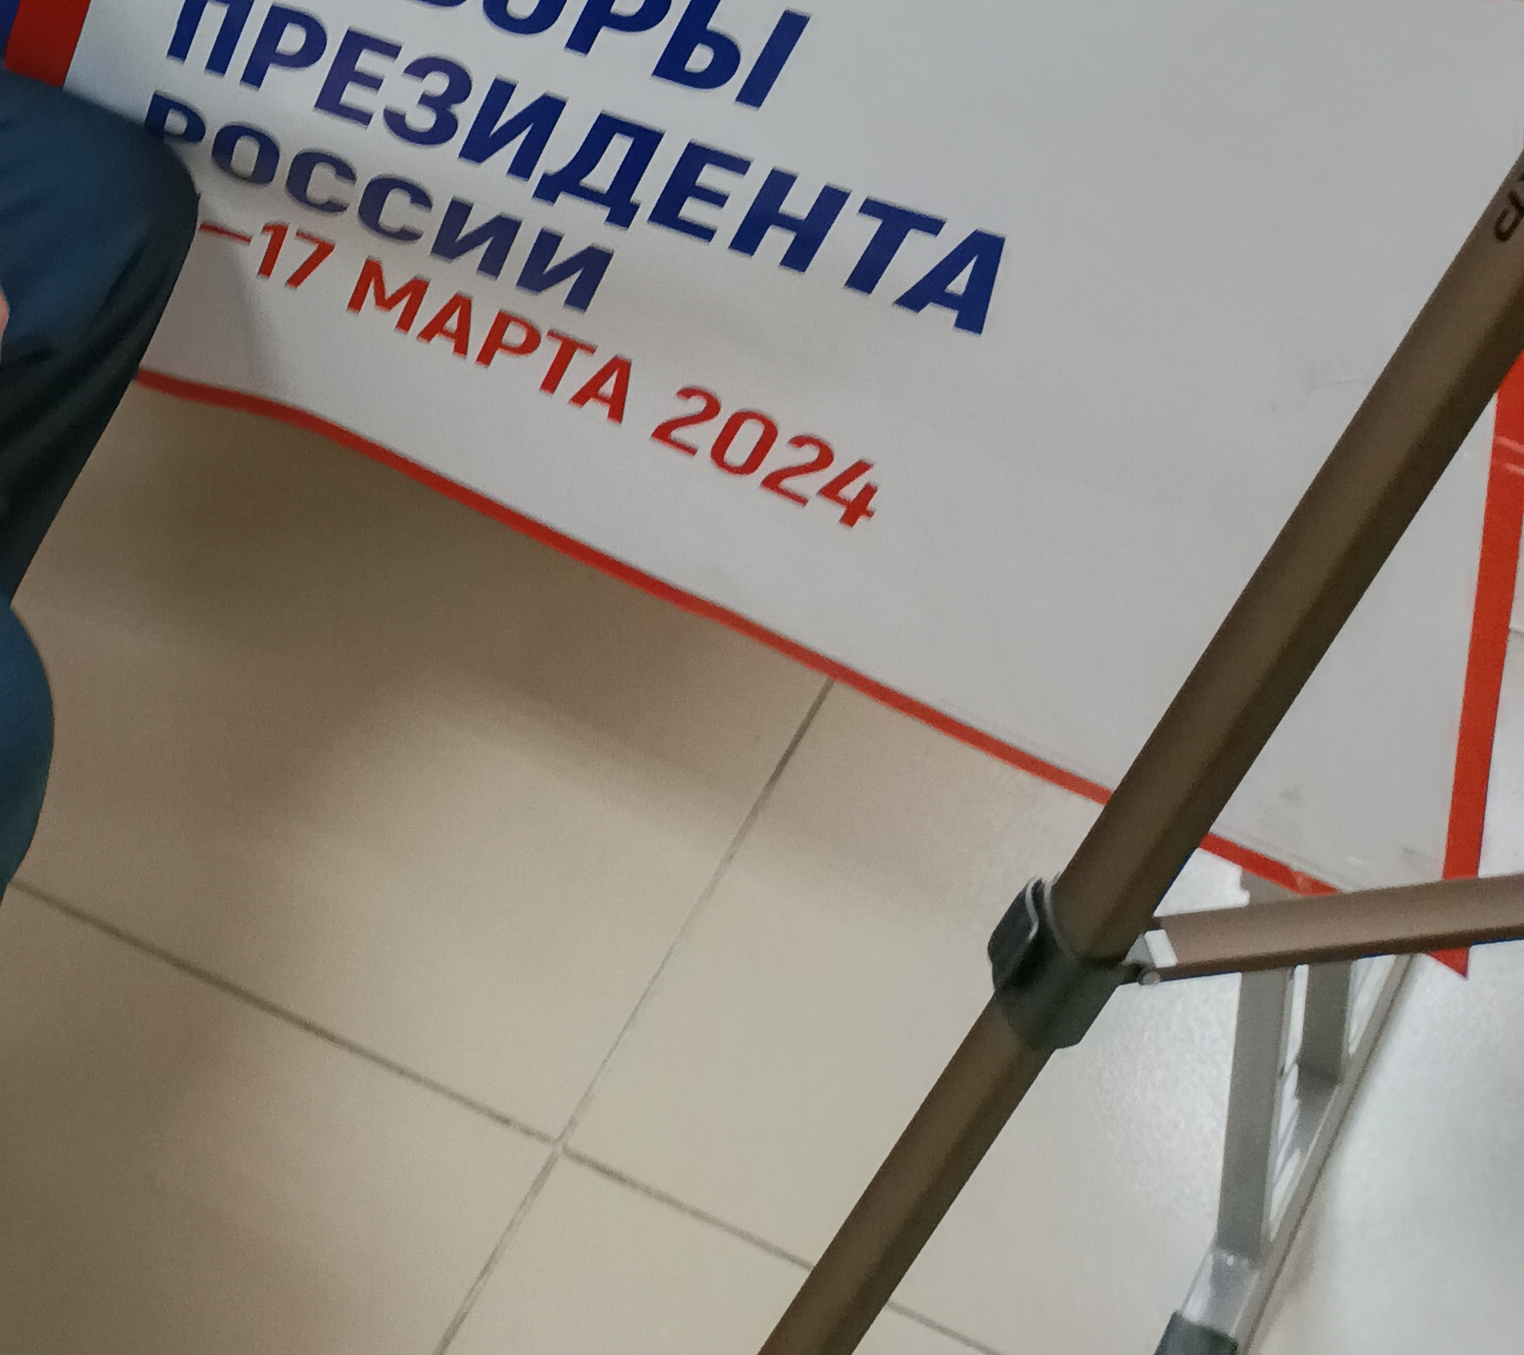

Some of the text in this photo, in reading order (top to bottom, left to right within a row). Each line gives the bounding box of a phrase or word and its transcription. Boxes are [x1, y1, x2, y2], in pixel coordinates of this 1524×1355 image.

[144, 91, 615, 314] РОССИИ
[346, 256, 636, 425] МАРТА
[651, 384, 882, 530] 2024
